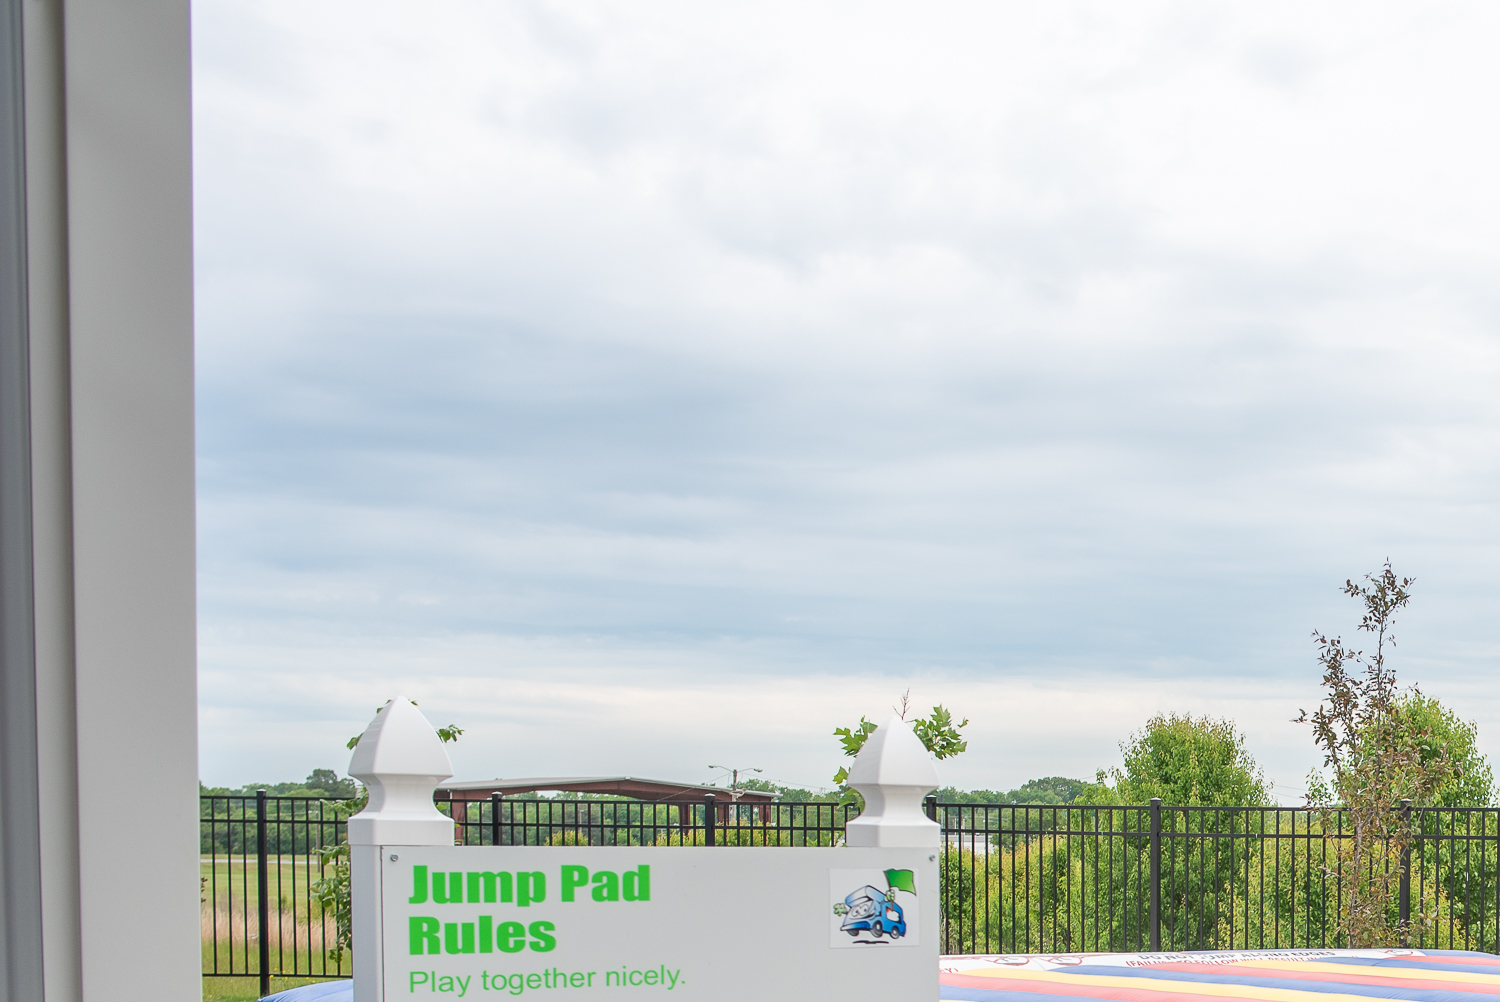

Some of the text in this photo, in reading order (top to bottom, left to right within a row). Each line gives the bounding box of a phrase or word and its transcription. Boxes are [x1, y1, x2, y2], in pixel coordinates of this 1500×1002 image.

[407, 863, 652, 908] Jump Pad
[407, 914, 558, 957] Rules
[408, 963, 686, 999] Play together nicely.
